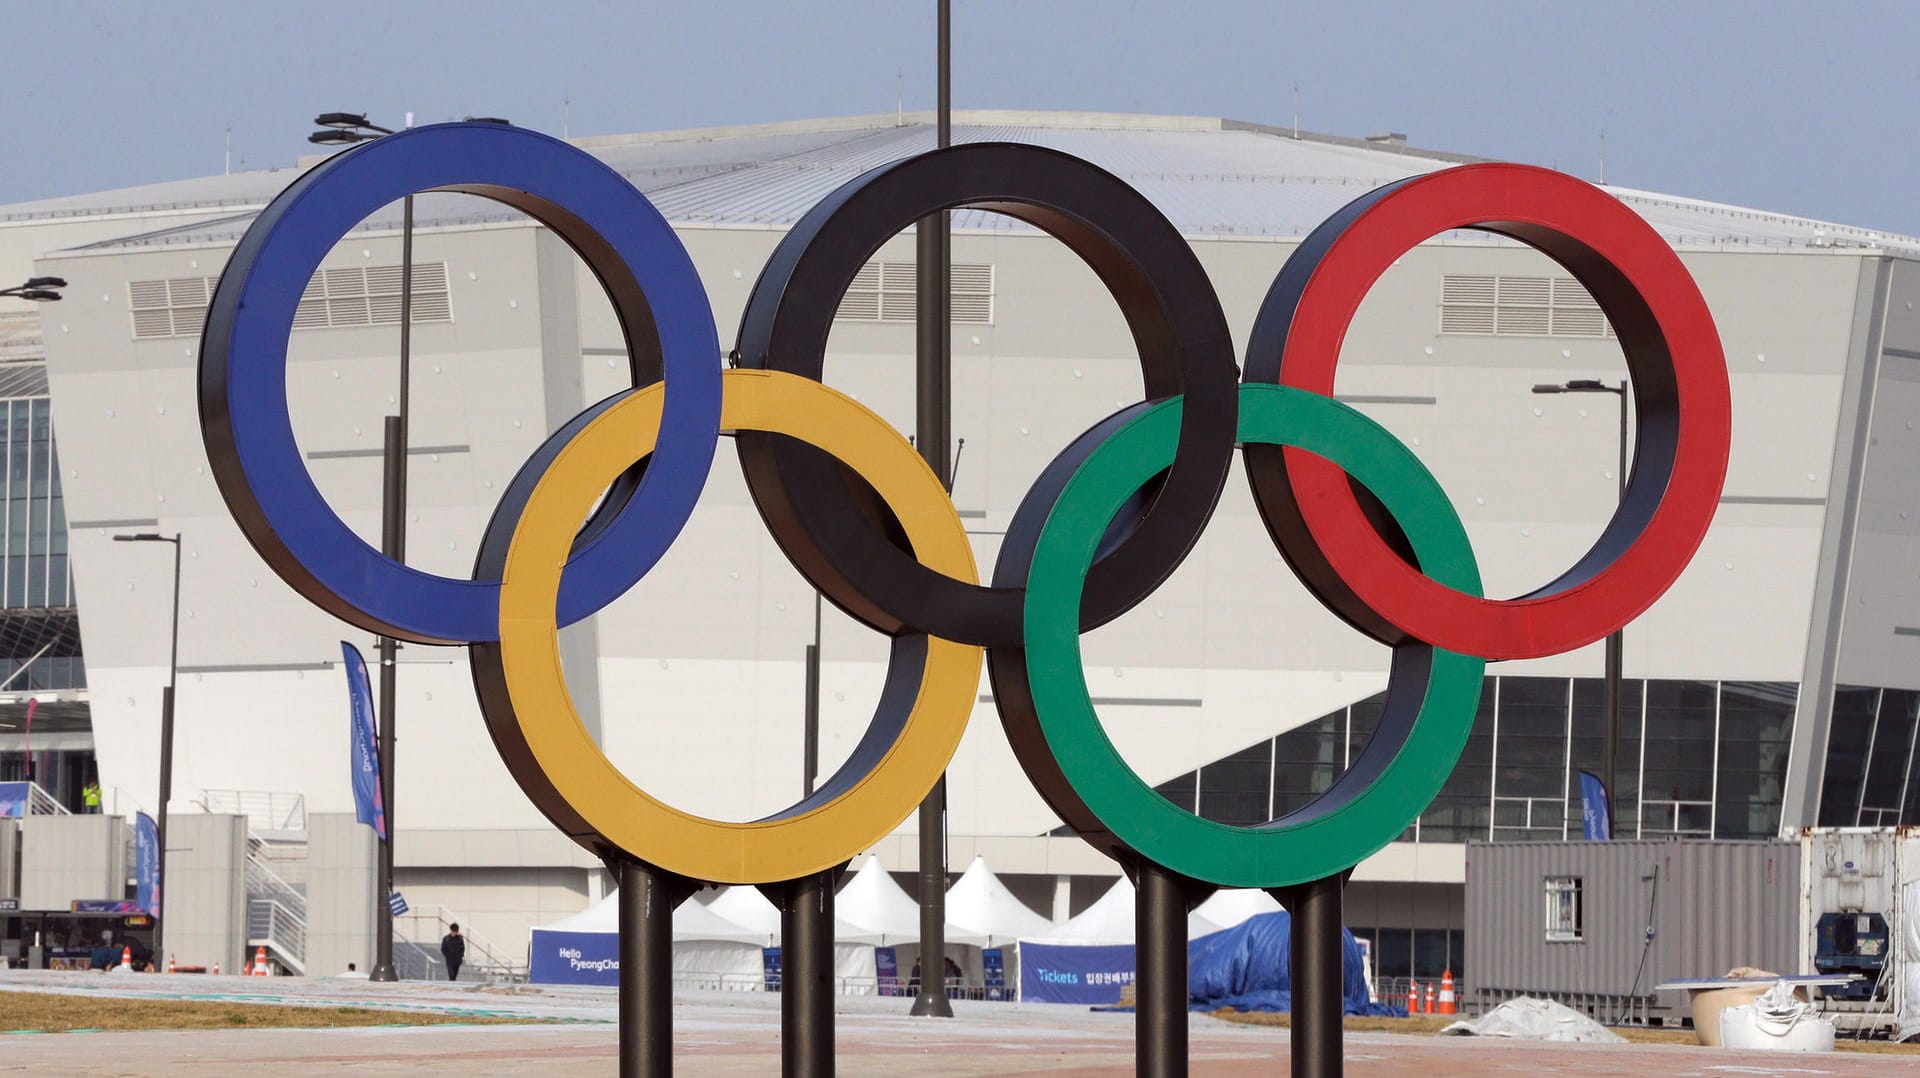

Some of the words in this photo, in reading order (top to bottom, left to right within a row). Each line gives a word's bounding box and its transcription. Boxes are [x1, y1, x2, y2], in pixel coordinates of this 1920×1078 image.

[559, 948, 582, 958] Hello
[571, 958, 619, 971] PyeongCha
[1037, 968, 1078, 984] Tickets
